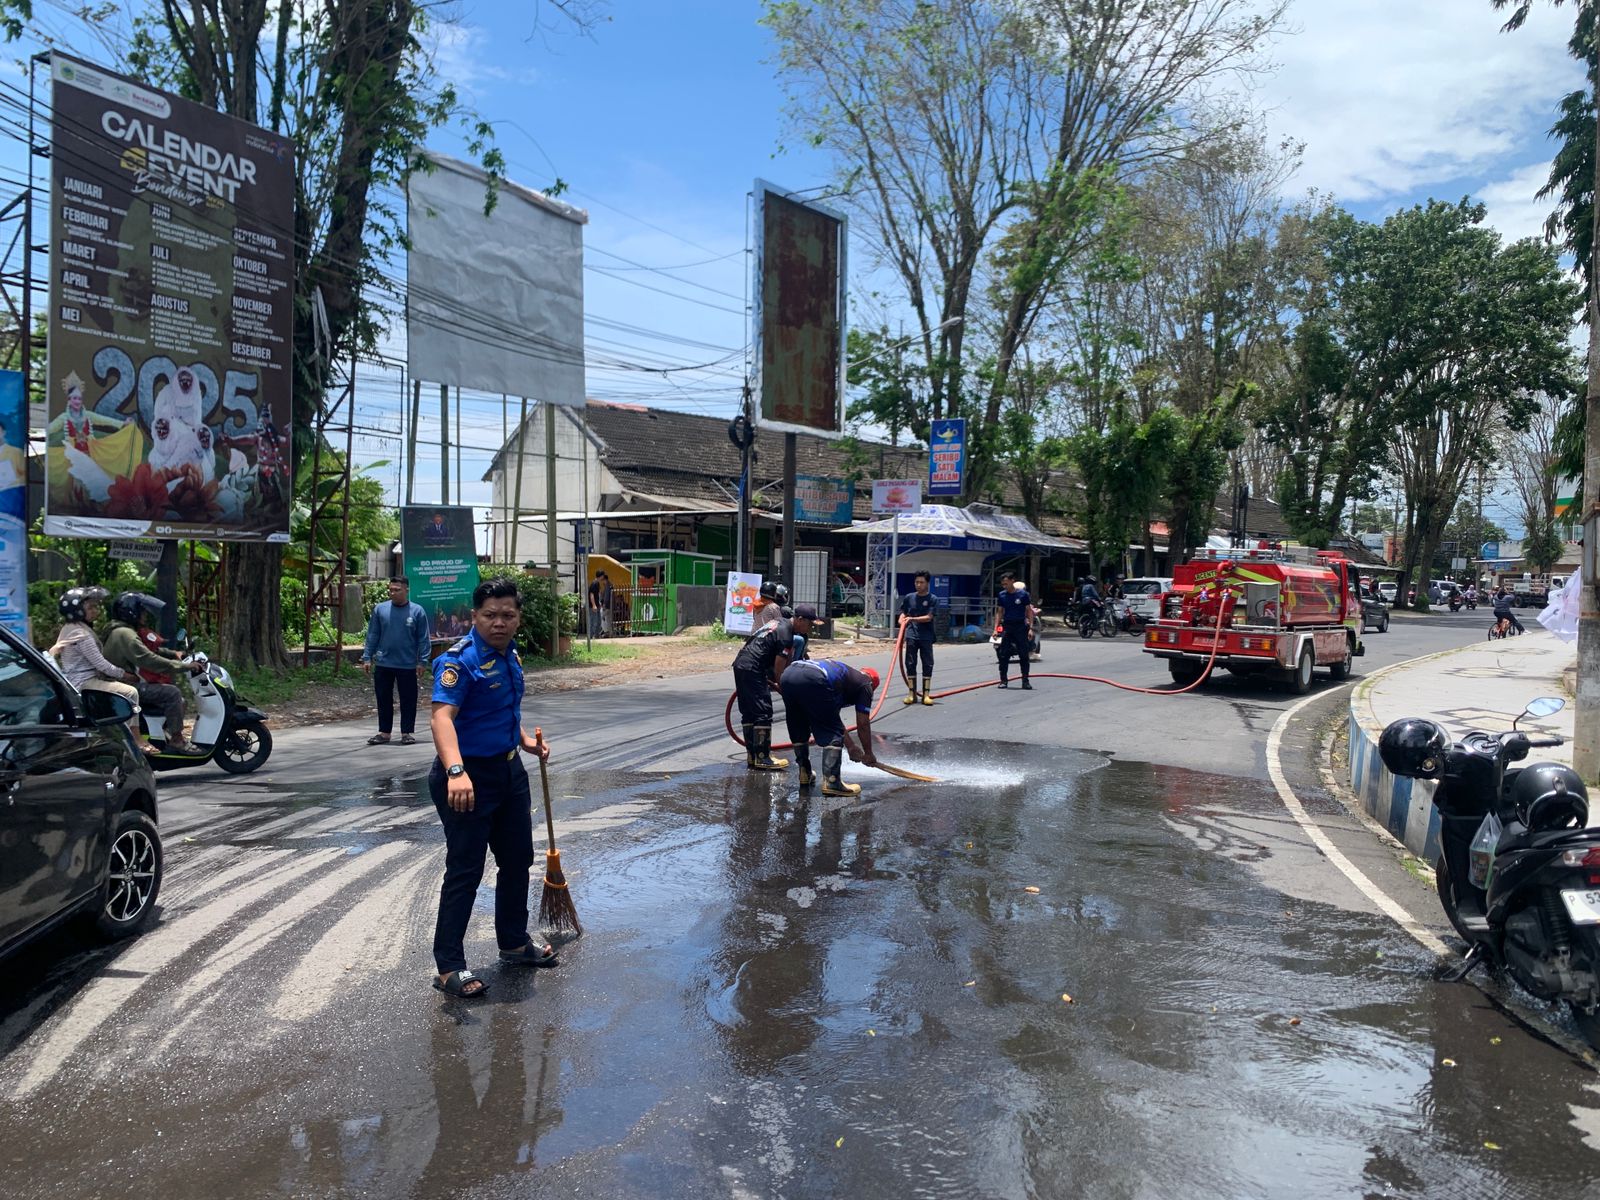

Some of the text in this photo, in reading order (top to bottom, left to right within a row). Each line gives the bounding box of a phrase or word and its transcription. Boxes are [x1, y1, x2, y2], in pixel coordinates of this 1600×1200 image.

[101, 110, 257, 185] CALENDAR
[147, 151, 241, 204] EVENT
[64, 177, 102, 199] JANUARI
[64, 207, 108, 230] FEBRUARI
[152, 202, 171, 221] JUNI
[233, 227, 278, 251] SEPTEMBER
[63, 241, 95, 260] MARET
[152, 246, 169, 261] JULI
[234, 256, 266, 275] OKTOBER
[63, 271, 90, 289] APRIL
[152, 294, 188, 313] AGUSTUS
[233, 296, 271, 315] NOVEMBER
[62, 307, 80, 322] MEI
[233, 342, 271, 360] DESEMBER
[93, 345, 260, 440] 2025
[933, 452, 960, 463] SERIBU
[932, 472, 960, 482] MALAM
[937, 462, 956, 473] SATU
[1566, 893, 1577, 906] P
